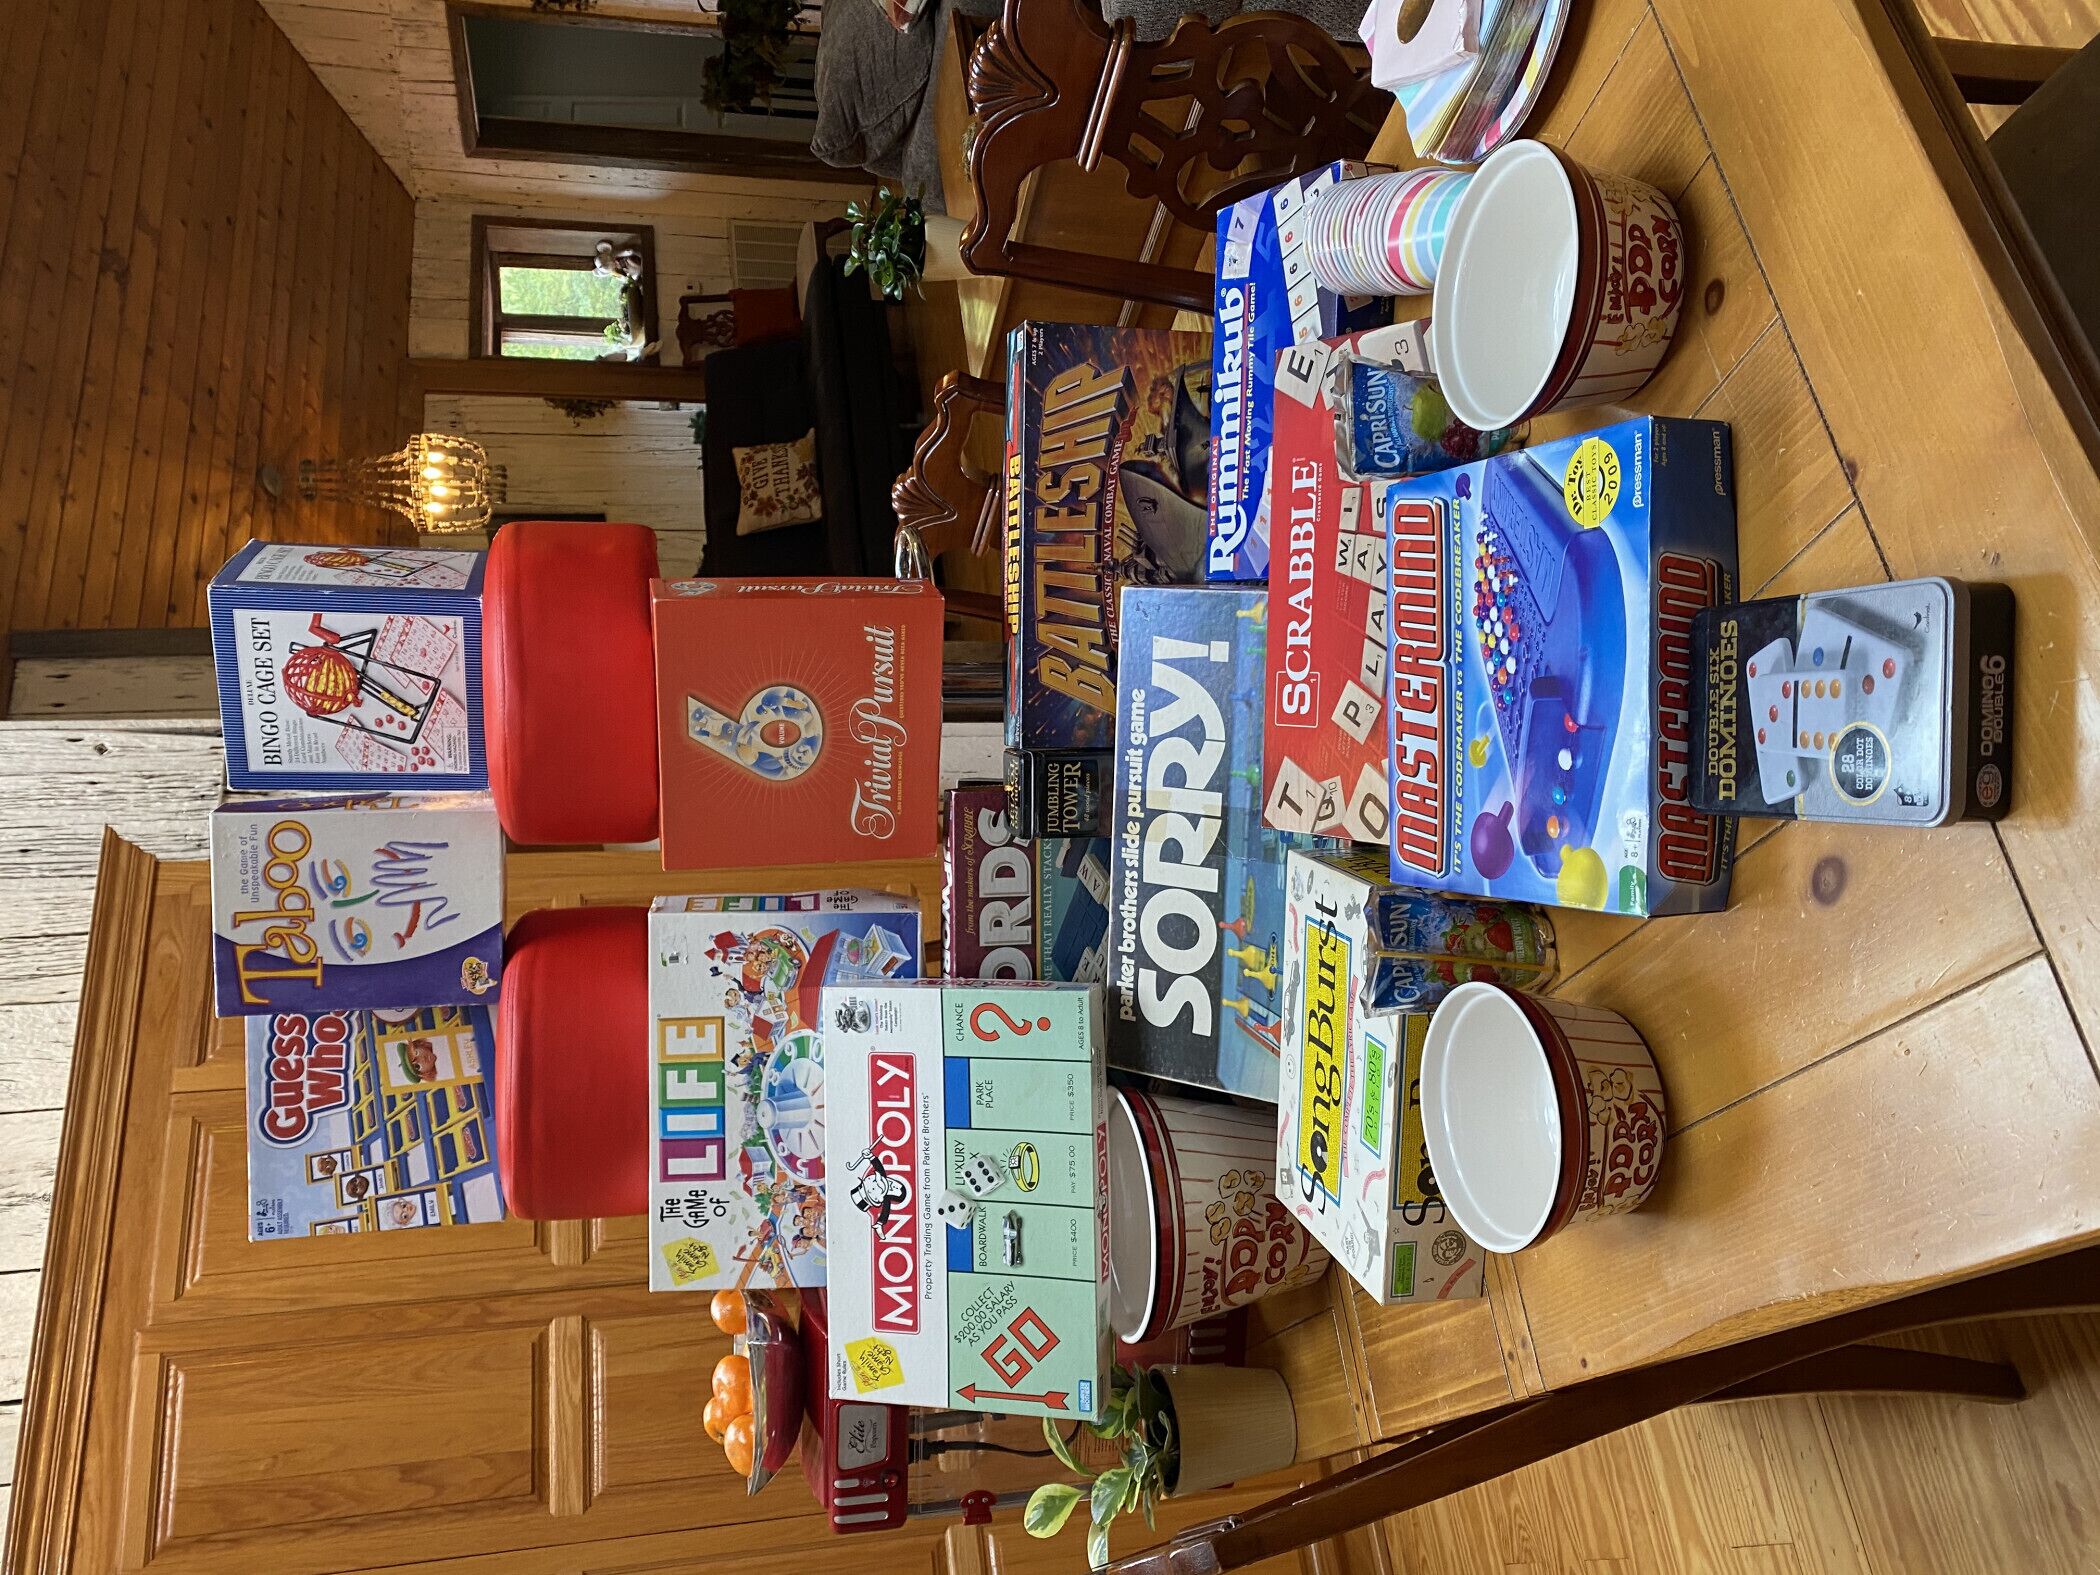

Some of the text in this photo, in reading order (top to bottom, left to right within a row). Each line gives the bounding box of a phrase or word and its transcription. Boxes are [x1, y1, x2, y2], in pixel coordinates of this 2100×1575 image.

[1234, 216, 1244, 230] 7
[1626, 223, 1654, 314] POP
[1650, 214, 1678, 303] CORN
[1248, 282, 1256, 323] Game!
[1246, 350, 1256, 396] Rummy
[1286, 349, 1314, 384] E
[1209, 287, 1247, 573] Rummikub
[1244, 400, 1254, 446] Moving
[751, 458, 769, 490] GIVE
[772, 445, 791, 498] THANKS
[1242, 478, 1250, 500] The
[1567, 455, 1583, 516] Dr. Toy
[1604, 452, 1618, 506] 2009
[1632, 432, 1644, 508] pressman
[1712, 430, 1727, 496] pressman
[1007, 453, 1021, 633] BATTLESHIP
[1034, 362, 1134, 715] BATTLESHIP
[1103, 439, 1124, 644] THE CLASSIC NAVAL COMBAT GAME
[1338, 539, 1348, 566] W
[1282, 460, 1318, 715] SCRABBLE
[250, 617, 282, 766] BINGO CAGE SET
[1394, 498, 1441, 873] MASTERMIND
[1452, 498, 1464, 873] IT'S THE CODEMAKER vs THE CODEBREAKER
[1980, 654, 2006, 675] 6
[246, 679, 254, 706] DELUXE
[1342, 700, 1361, 728] P
[1657, 552, 1708, 881] MASTERMIND
[1708, 646, 1720, 776] DOUBLE SIX
[1718, 619, 1738, 800] DOMINOES
[1980, 675, 1994, 756] DOMINO
[1994, 674, 2004, 743] DOUBLE
[686, 684, 823, 781] 6
[778, 722, 786, 744] VOLUME
[848, 625, 908, 840] Trivial Pursuit
[1842, 754, 1854, 773] 28
[1856, 738, 1864, 790] COLOR DOT
[1047, 762, 1061, 832] JUMBLING
[1062, 762, 1081, 832] TOWER
[1277, 781, 1304, 816] T
[964, 855, 975, 866] of
[1118, 688, 1147, 1022] parker brothers slide pursuit game
[1137, 635, 1230, 1037] SORRY!
[1720, 816, 1732, 870] IT'S THE
[239, 836, 249, 894] the Game of
[249, 824, 260, 903] Unspeakable Fun
[966, 868, 974, 898] makers
[231, 820, 323, 1005] Taboo
[964, 914, 976, 935] from
[965, 899, 974, 912] the
[1043, 838, 1052, 961] THAT REALLY STACKS
[955, 1002, 964, 1042] CHANCE
[1078, 1016, 1084, 1024] to
[265, 1013, 308, 1140] Guess
[306, 1009, 346, 1110] Who
[1300, 894, 1342, 1215] SongBurst
[1368, 1050, 1377, 1084] 80's
[662, 1020, 722, 1179] LIFE
[976, 1082, 984, 1106] PARK
[984, 1080, 994, 1108] PLACE
[1364, 1104, 1374, 1139] 70's
[1628, 1100, 1658, 1186] CORN
[922, 1136, 930, 1166] Parker
[954, 1139, 966, 1186] LUXURY
[1604, 1119, 1636, 1198] POP
[922, 1168, 930, 1190] from
[428, 1199, 436, 1217] EMILY
[1070, 1218, 1078, 1243] $400
[923, 1223, 932, 1256] Trading
[978, 1206, 988, 1267] BOARDWALK
[1226, 1218, 1265, 1296] POP
[1264, 1202, 1295, 1285] CORN
[924, 1260, 933, 1300] Property
[960, 1286, 995, 1322] COLLECT
[952, 1280, 1016, 1344] $200.00 SALARY
[967, 1294, 1018, 1348] AS YOU PASS
[860, 1350, 881, 1382] Family
[867, 1350, 891, 1375] Game
[872, 1344, 894, 1365] Night
[980, 1306, 1061, 1389] GO
[848, 1420, 866, 1456] Elite
